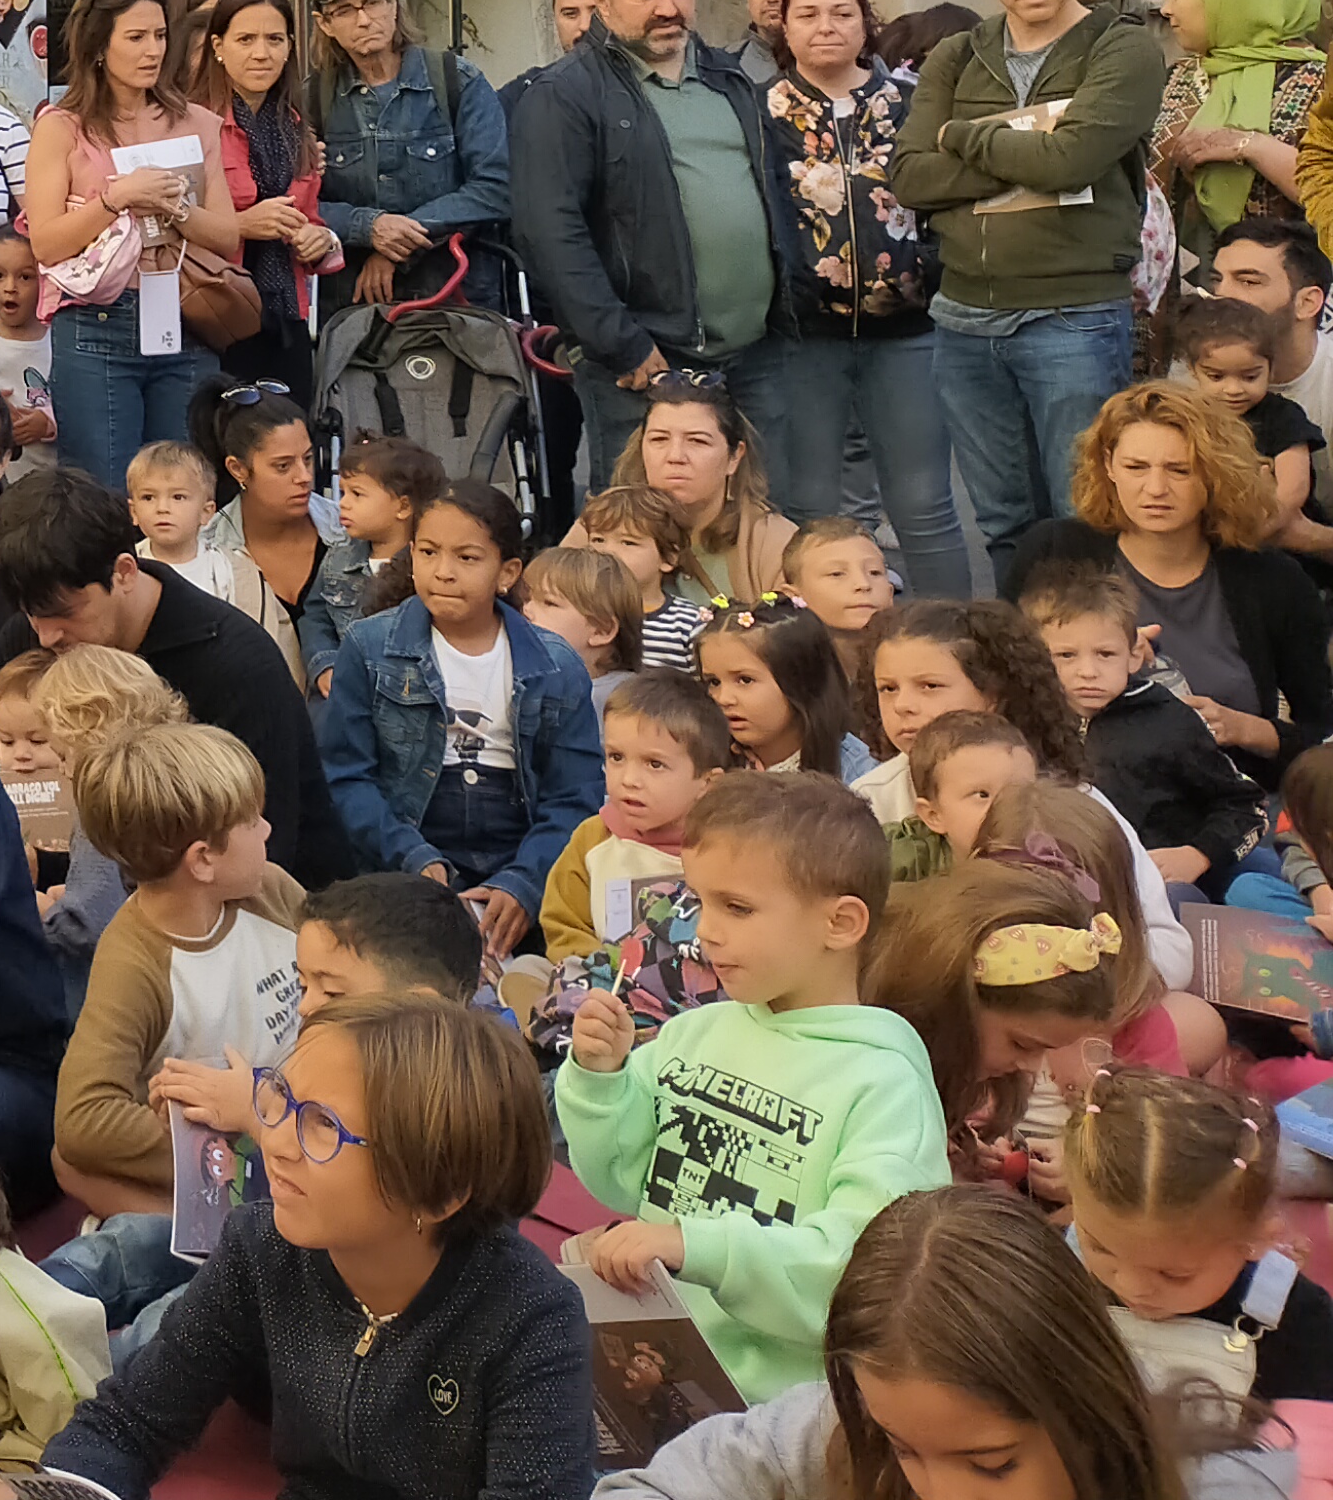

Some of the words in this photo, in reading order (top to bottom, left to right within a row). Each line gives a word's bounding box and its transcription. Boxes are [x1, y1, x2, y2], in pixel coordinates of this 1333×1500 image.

[256, 967, 288, 996] WHAT
[265, 1006, 290, 1031] DAY
[682, 1166, 706, 1185] TNT
[434, 1387, 453, 1405] LOVE
